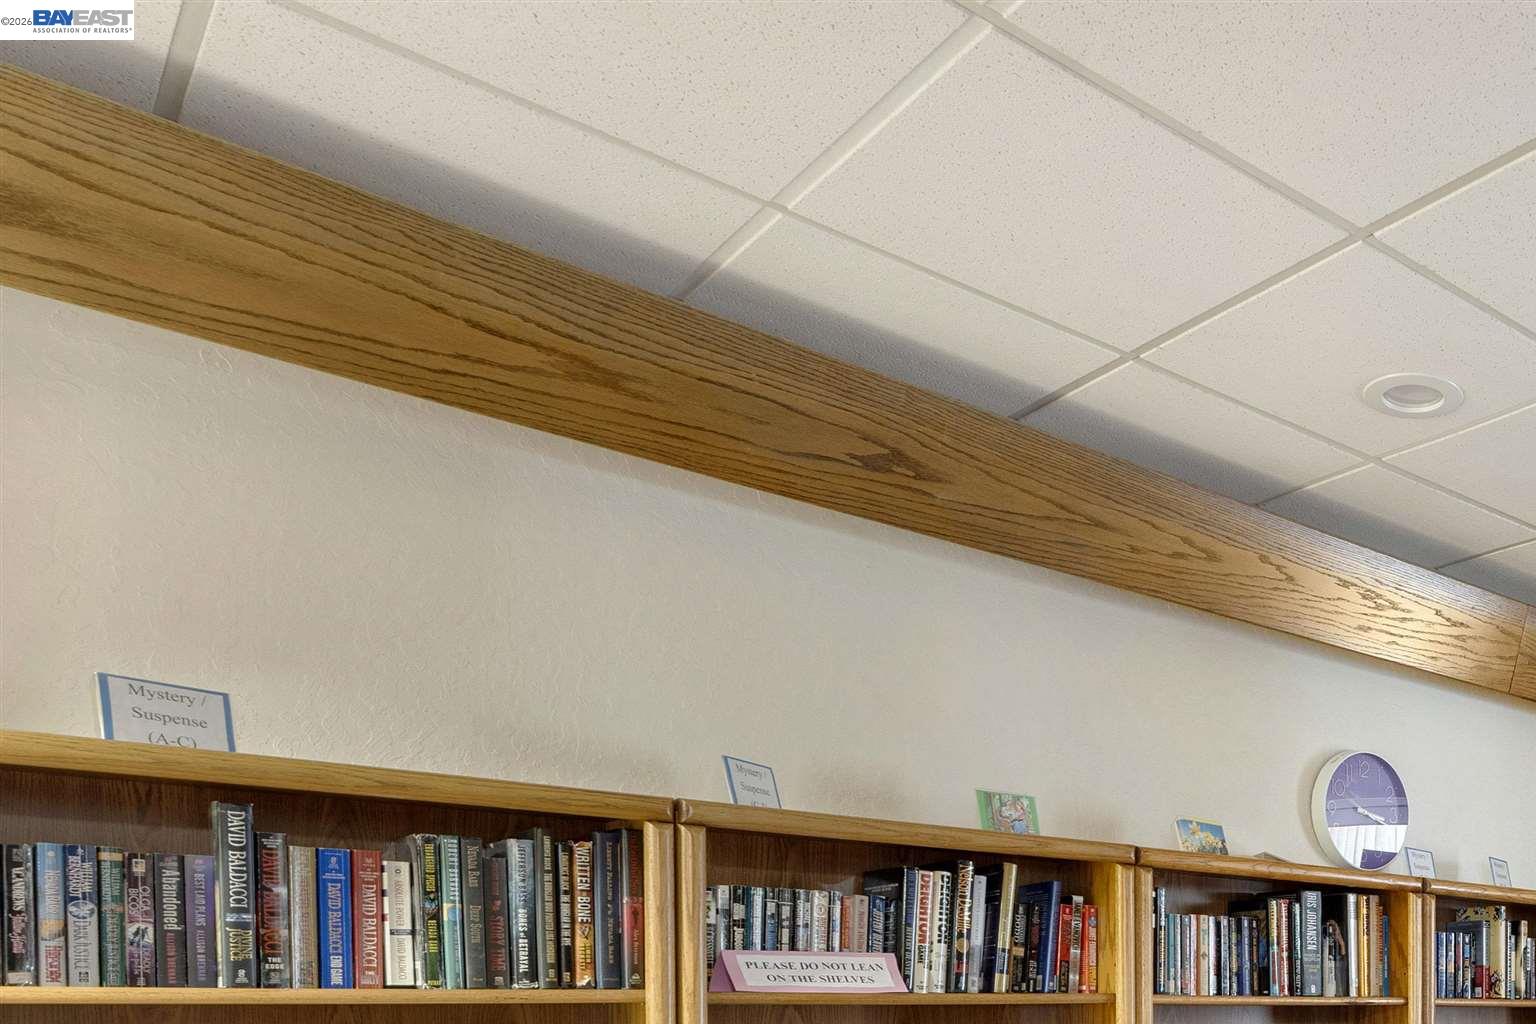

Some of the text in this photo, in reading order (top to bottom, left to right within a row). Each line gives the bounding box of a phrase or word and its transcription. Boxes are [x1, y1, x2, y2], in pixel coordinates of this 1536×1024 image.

[128, 683, 196, 708] Mystery
[131, 706, 208, 729] Suspense
[1359, 760, 1370, 778] 12
[1331, 778, 1346, 797] 10
[1384, 785, 1394, 803] 2
[1327, 800, 1337, 816] 9
[227, 810, 249, 909] DAVID BALDACCI
[576, 847, 592, 891] WRITTEN
[161, 868, 182, 931] Abandoned
[327, 882, 342, 910] DAVID
[576, 896, 592, 923] BONE
[917, 872, 931, 945] DEIGHTON
[956, 863, 972, 935] Nelson DeMille
[328, 911, 343, 955] BALDACCI
[362, 884, 378, 968] DAVID BALDACCI
[1306, 892, 1318, 951] IRIS JOHANSEN
[226, 927, 243, 962] JUSTICE
[240, 929, 254, 960] DIVINE
[518, 908, 529, 973] BONES BETRAYAL
[745, 960, 885, 972] PLEASE DO NOT LEAN
[767, 973, 876, 985] ON THE SHELVES
